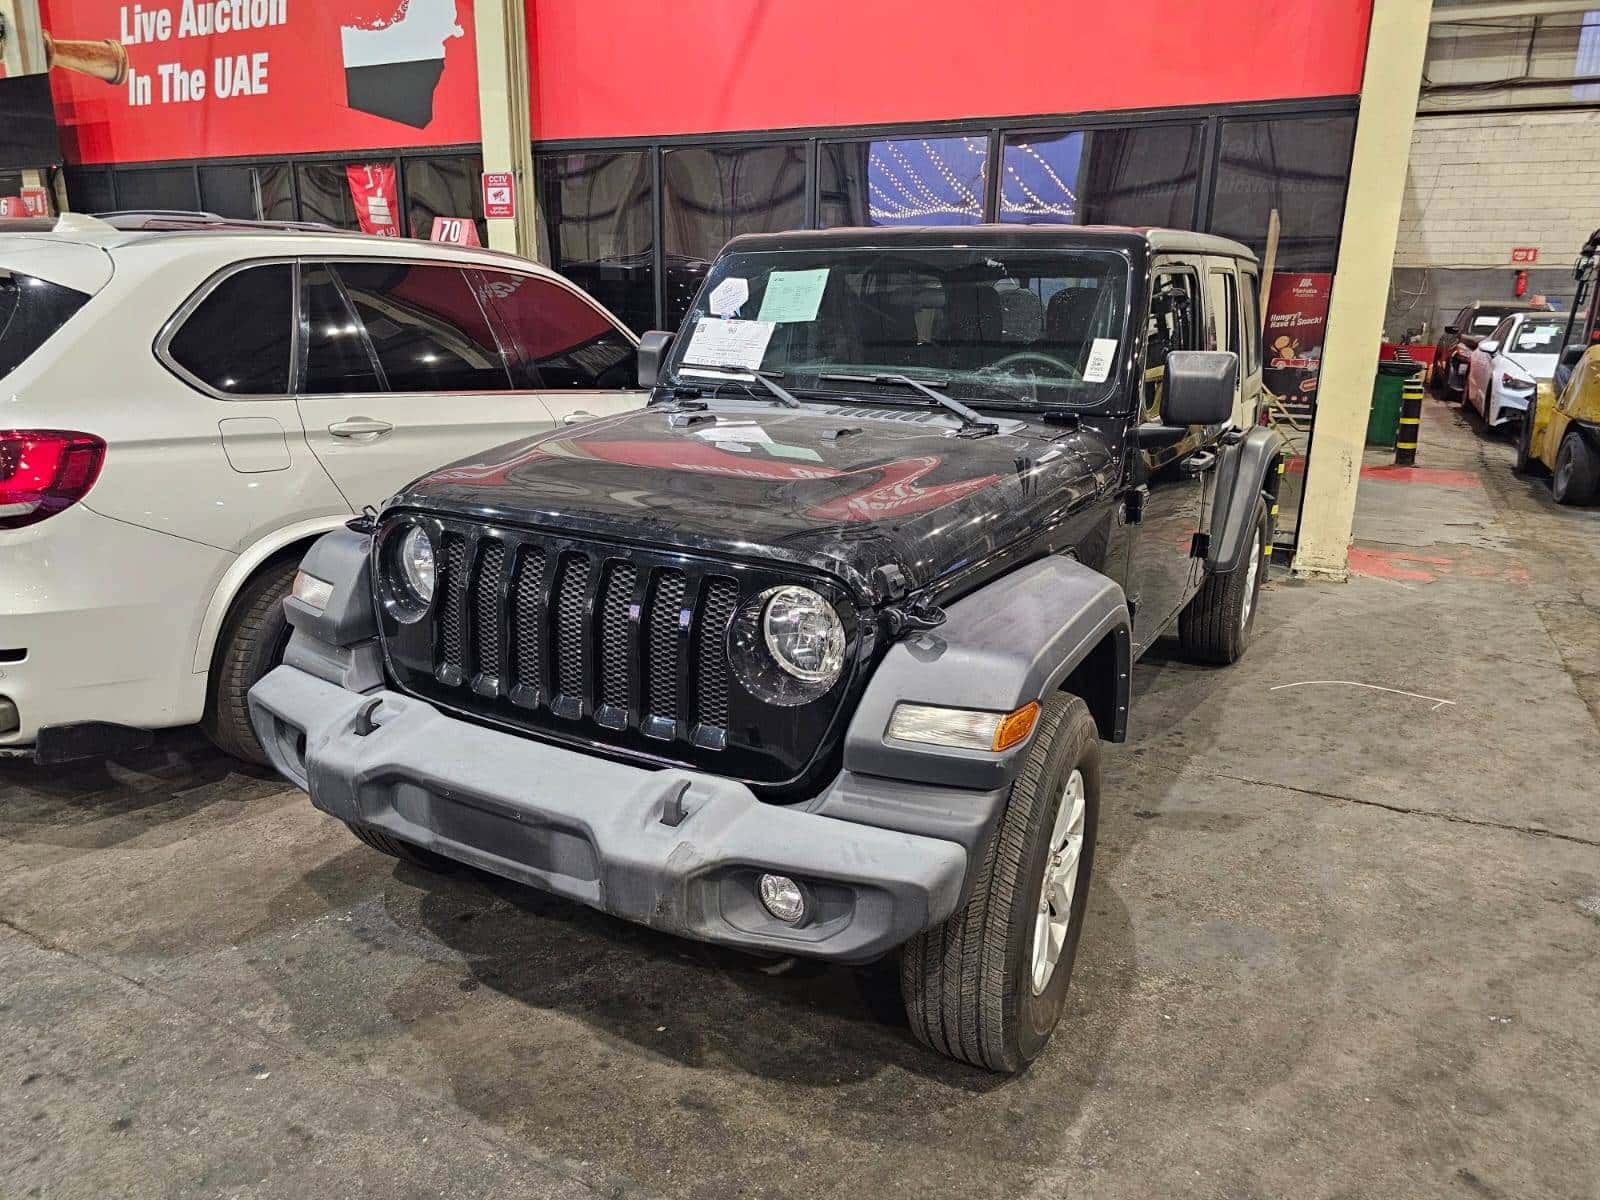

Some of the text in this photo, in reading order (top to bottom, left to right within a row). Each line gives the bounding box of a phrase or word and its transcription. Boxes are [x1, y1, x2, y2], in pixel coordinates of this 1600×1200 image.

[120, 0, 287, 45] Live Auction
[128, 52, 269, 106] In The UAE
[488, 175, 508, 183] CCTV
[440, 220, 461, 242] 70
[1270, 321, 1289, 329] Have
[1297, 316, 1322, 326] Snack!
